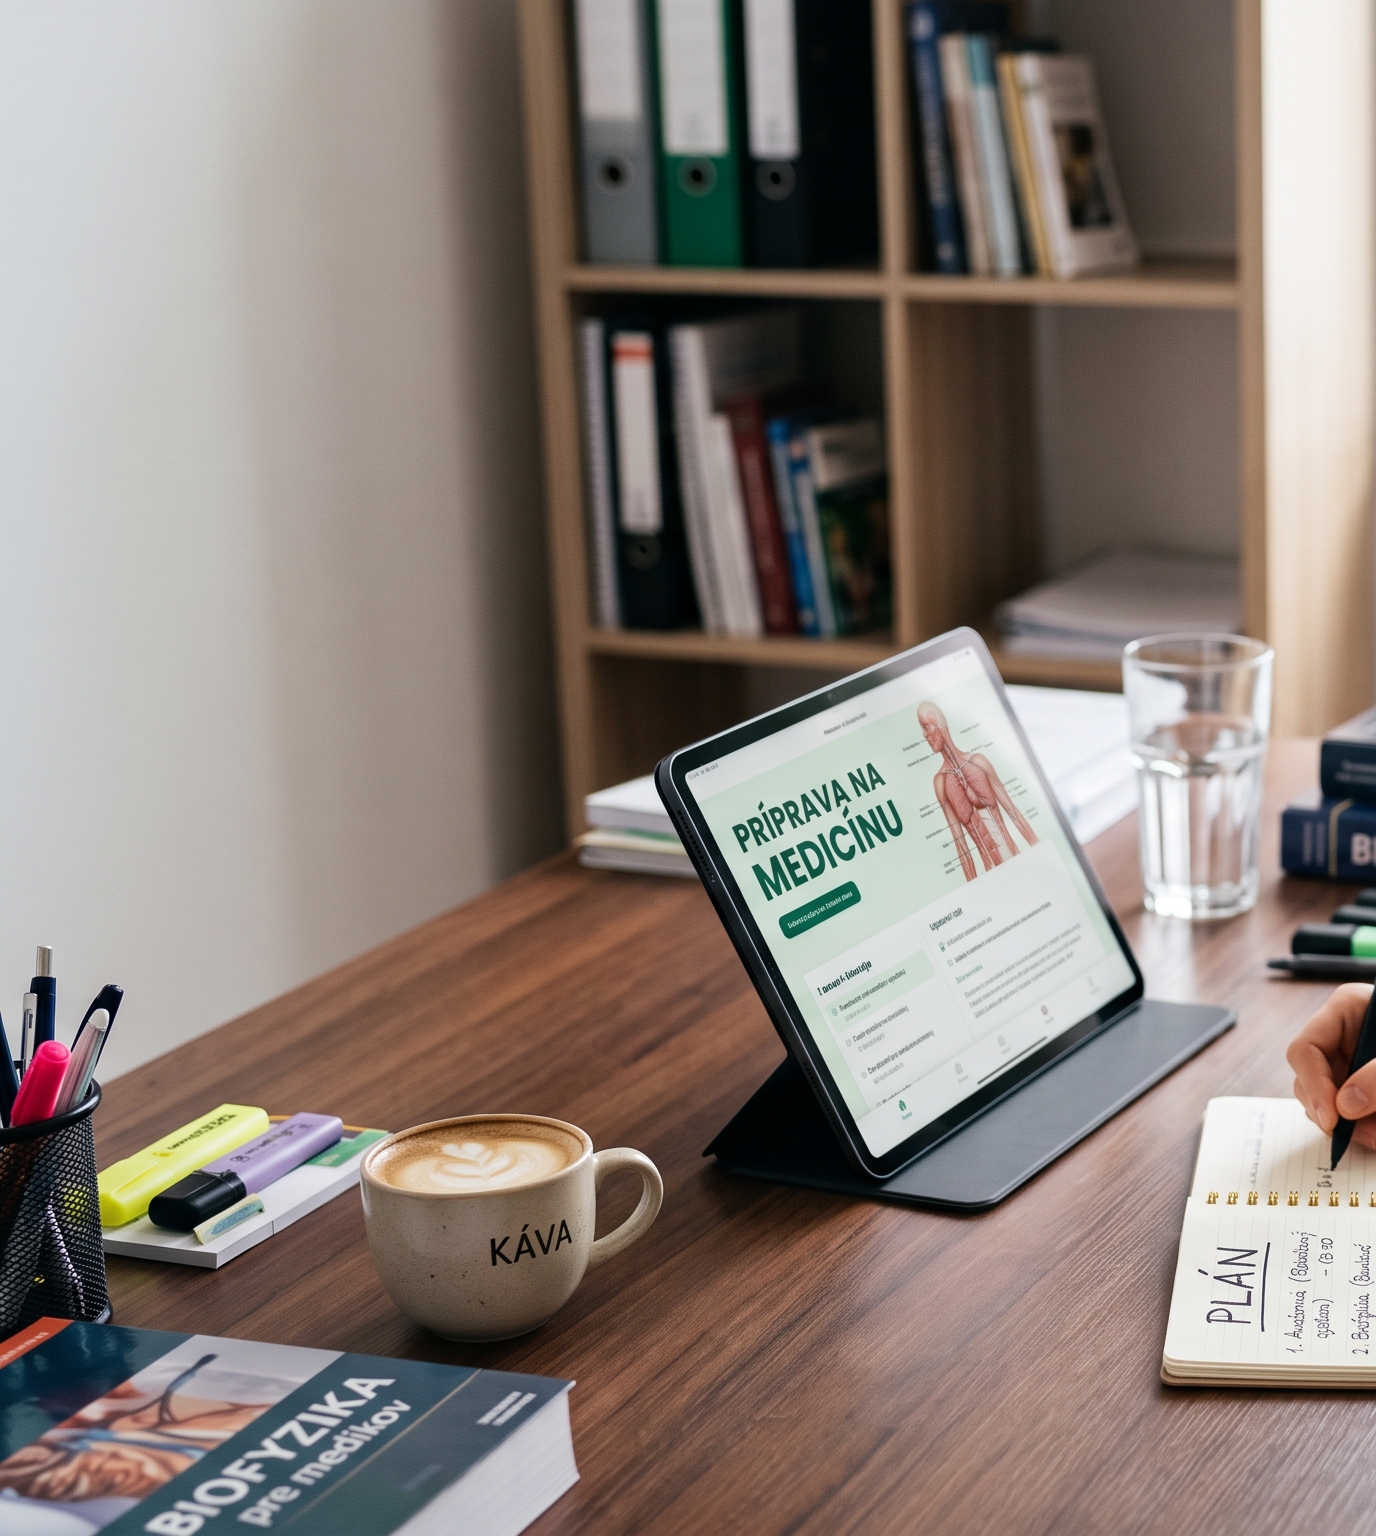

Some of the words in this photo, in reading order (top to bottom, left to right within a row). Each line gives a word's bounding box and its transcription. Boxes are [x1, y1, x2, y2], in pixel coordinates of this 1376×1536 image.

[732, 779, 852, 853] PRÍPRAVA
[846, 762, 887, 798] NA
[751, 799, 903, 902] MEDICÍNU
[490, 1219, 573, 1267] KÁVA
[1198, 1246, 1259, 1324] PLÁN
[144, 1376, 397, 1536] BIOFYZIKA
[237, 1484, 301, 1529] pre
[290, 1399, 413, 1487] medikov
